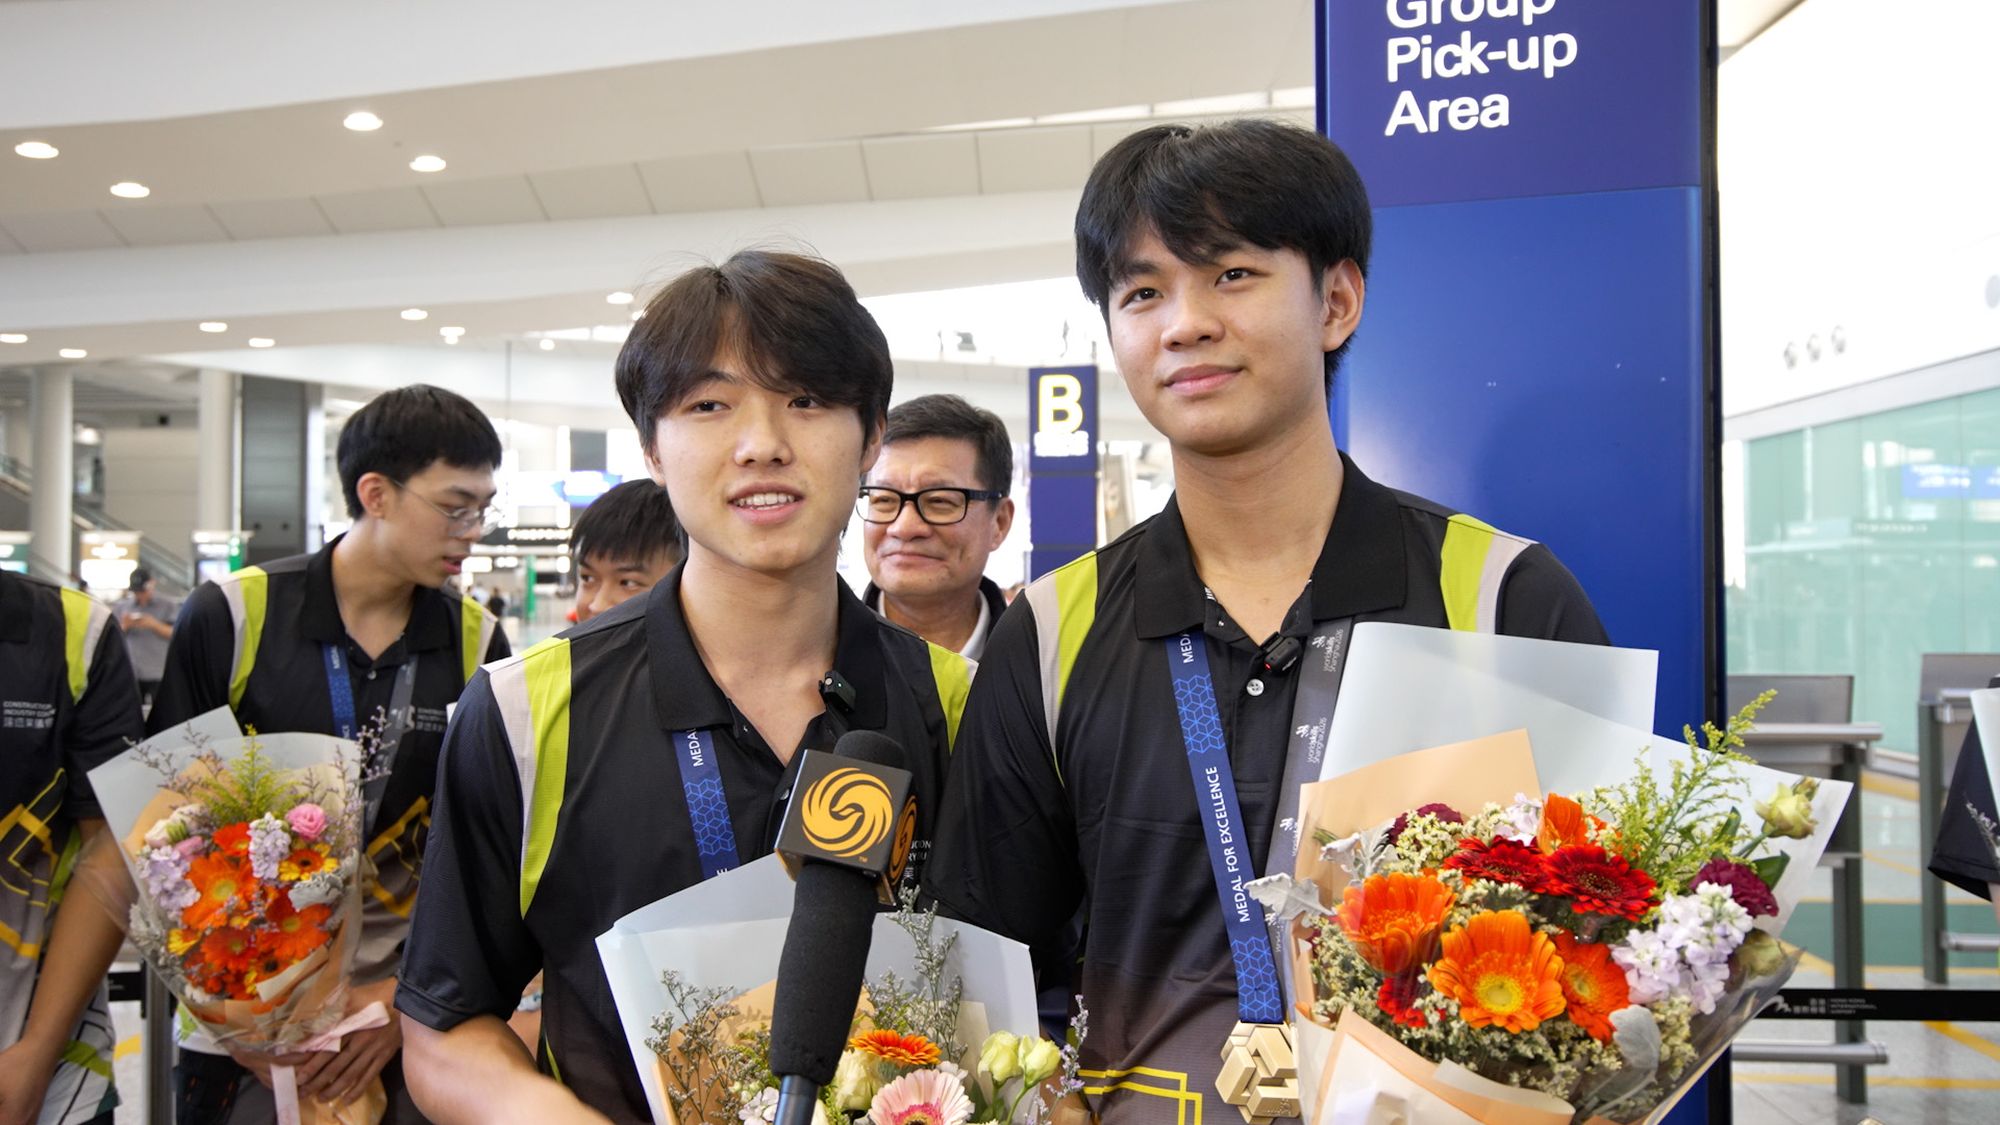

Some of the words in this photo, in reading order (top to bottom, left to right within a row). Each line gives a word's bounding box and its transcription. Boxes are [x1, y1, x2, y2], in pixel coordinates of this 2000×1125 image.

[1386, 0, 1556, 29] Group
[1387, 30, 1578, 83] Pick-up
[1384, 90, 1510, 136] Area
[1038, 374, 1083, 434] B
[1180, 633, 1195, 663] MED
[686, 728, 704, 767] MEDA
[1205, 766, 1233, 845] EXCELLENCE
[1224, 846, 1240, 873] FOR
[1230, 875, 1251, 923] MEDAL
